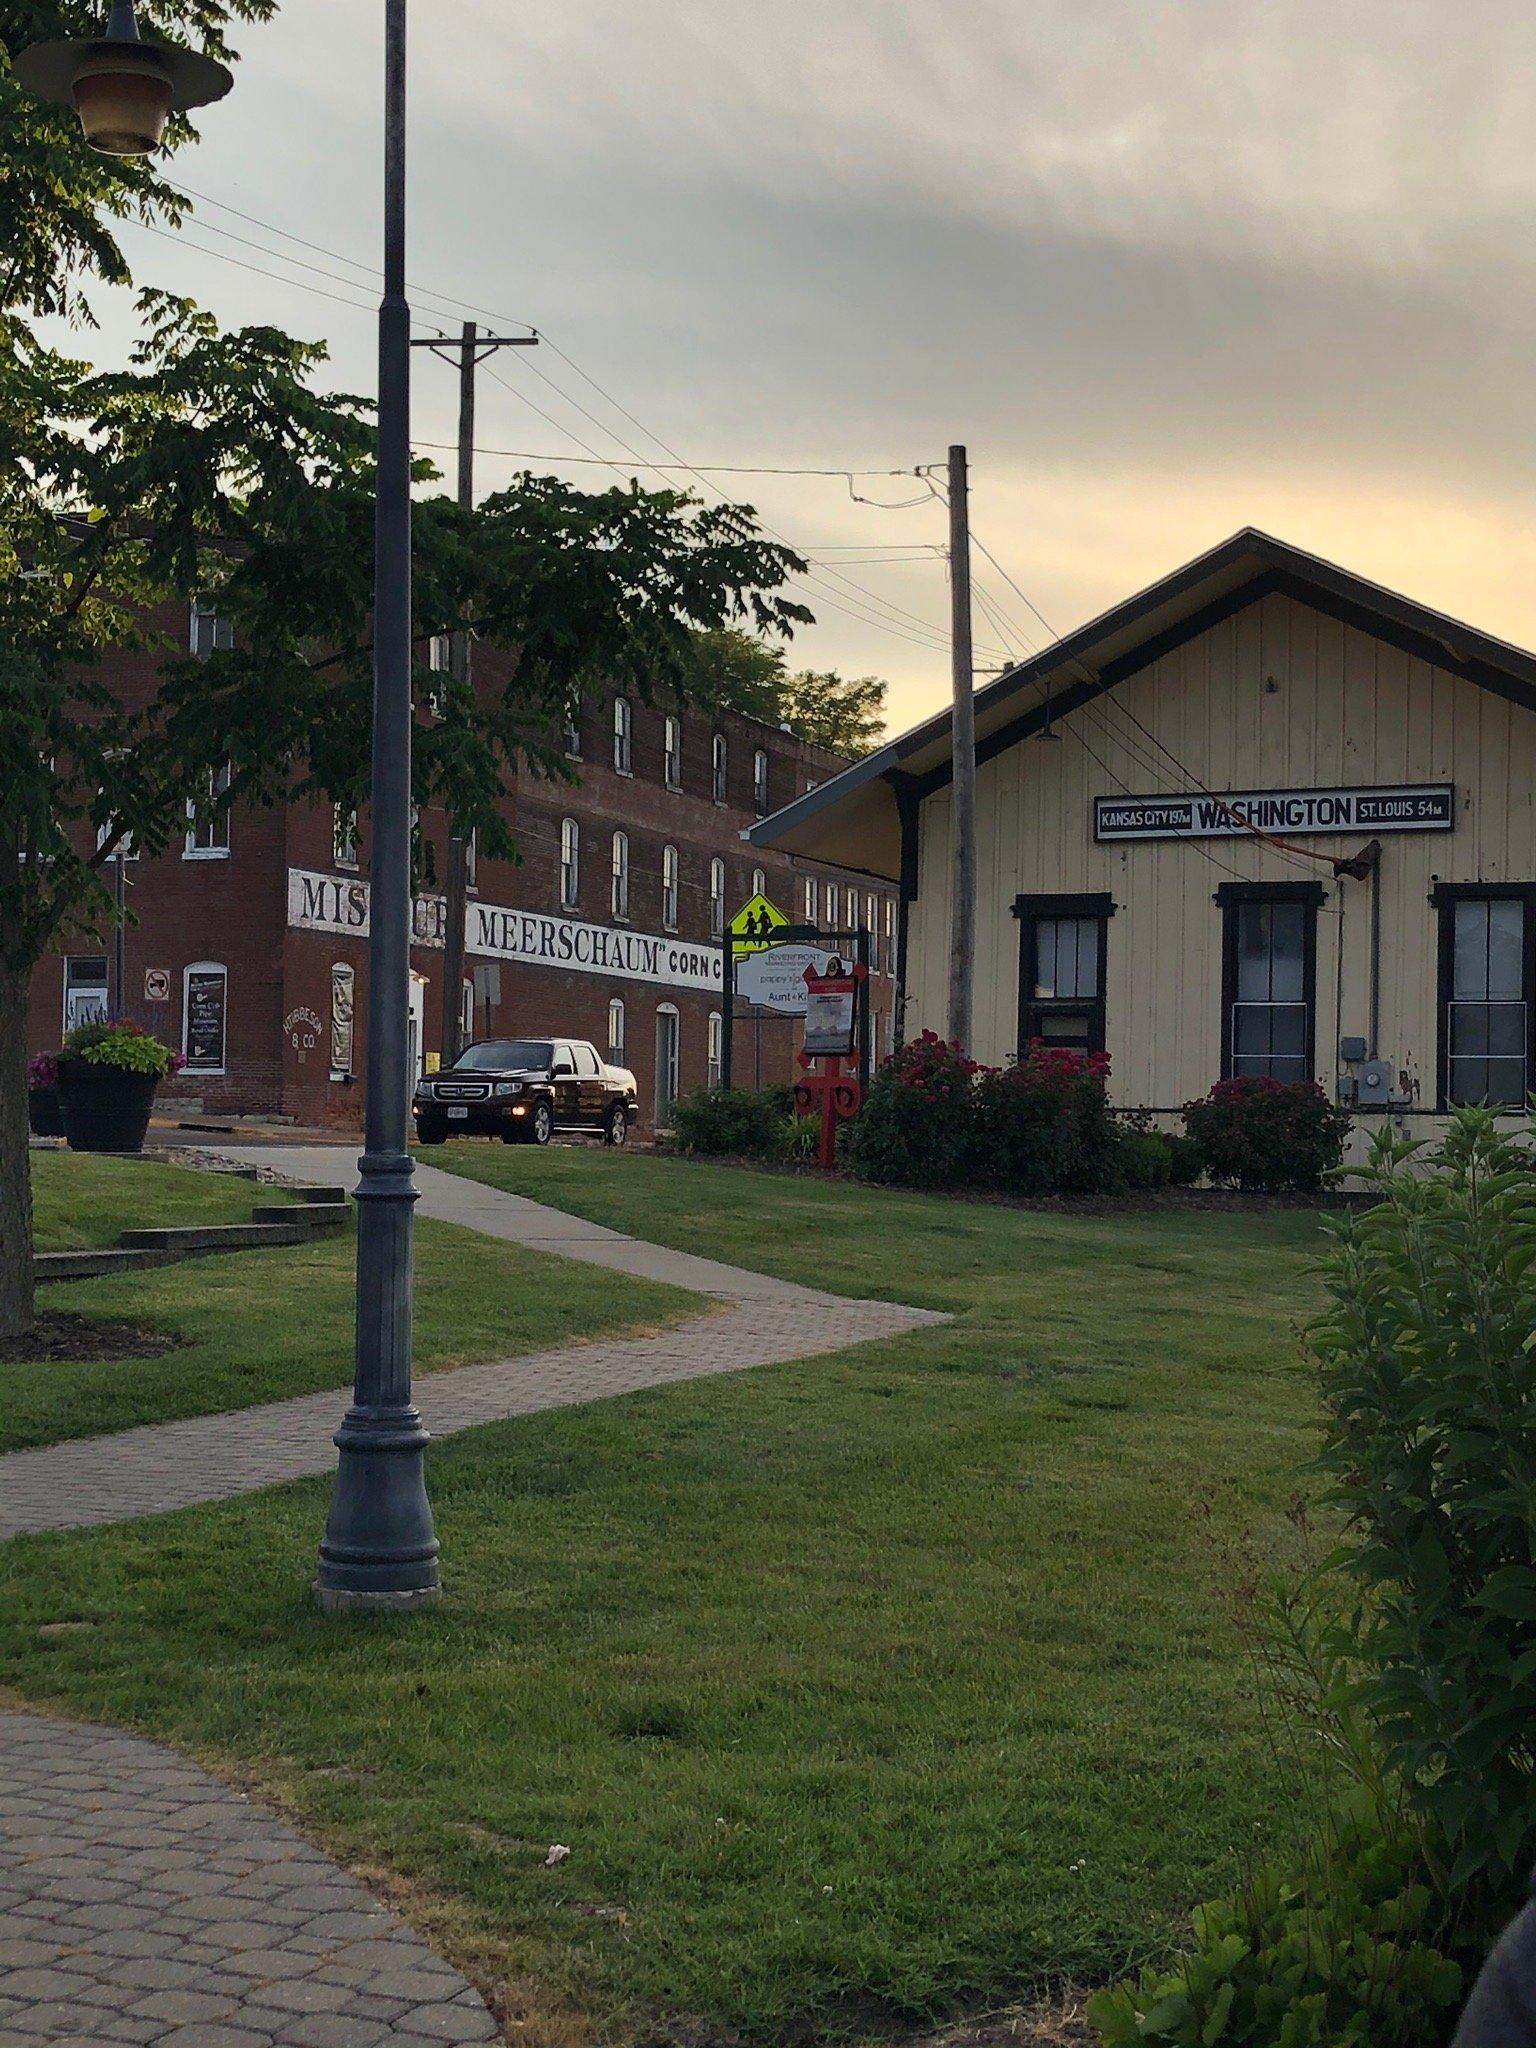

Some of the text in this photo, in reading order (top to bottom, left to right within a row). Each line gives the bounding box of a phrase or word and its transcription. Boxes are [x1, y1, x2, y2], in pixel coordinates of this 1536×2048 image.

[1197, 796, 1351, 830] WASHINGTON
[1378, 801, 1414, 817] LOUIS
[1101, 811, 1143, 827] KANSAS
[1144, 810, 1168, 825] CITY
[301, 876, 447, 941] MISUR
[669, 949, 709, 978] CORN
[768, 992, 791, 1001] Aunt
